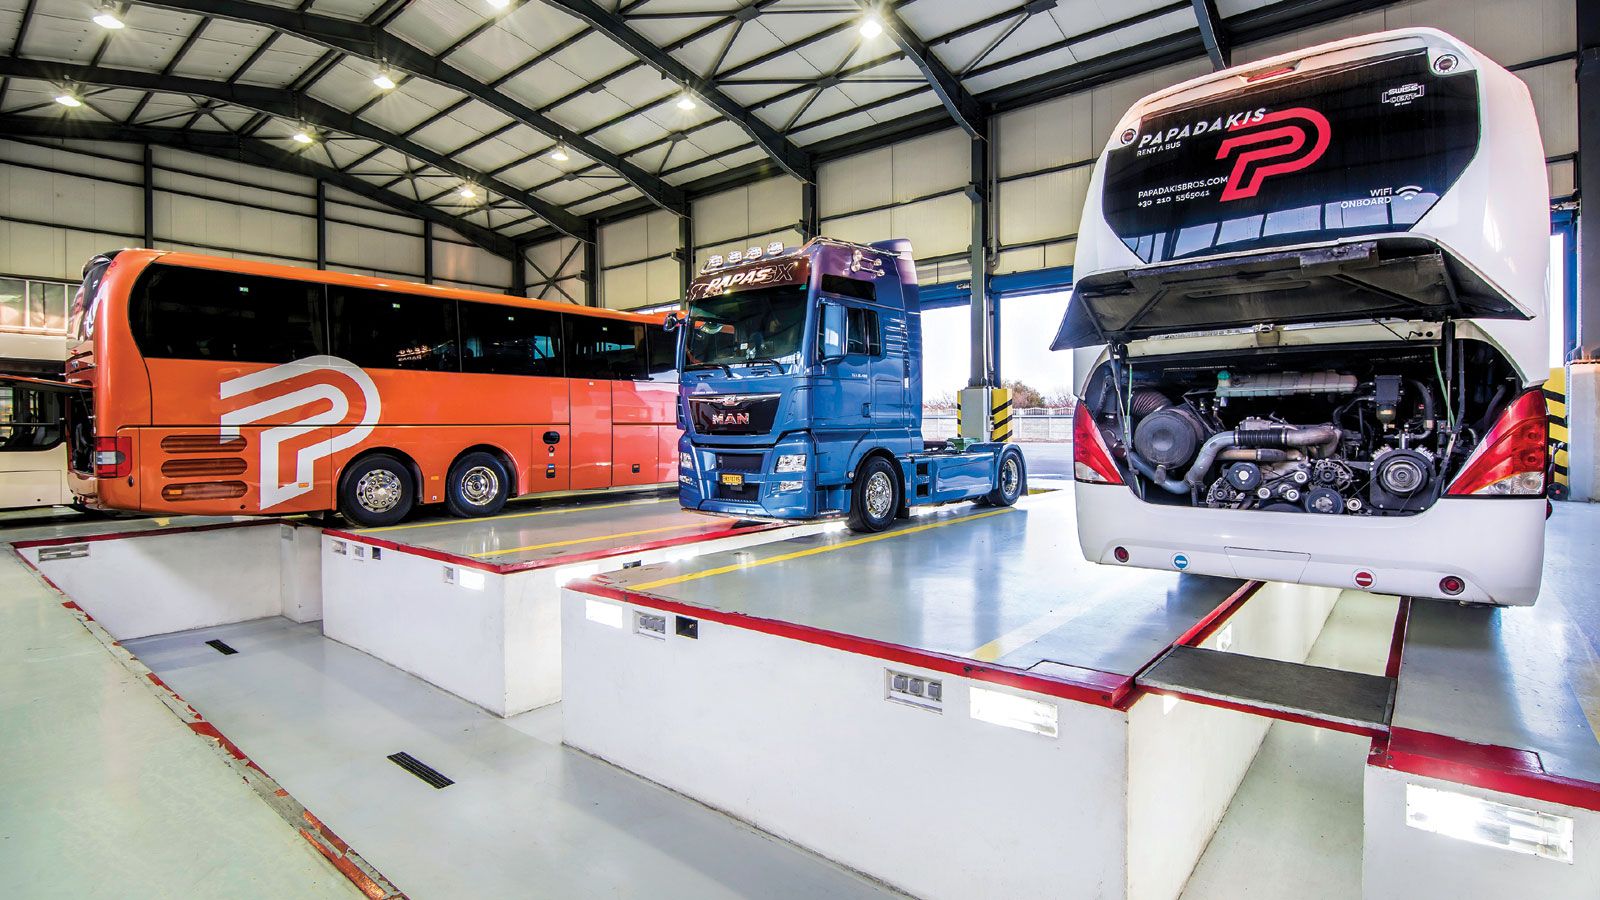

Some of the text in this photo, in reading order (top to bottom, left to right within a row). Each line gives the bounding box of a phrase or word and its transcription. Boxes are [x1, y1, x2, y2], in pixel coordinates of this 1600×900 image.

[1138, 107, 1266, 148] PAPADAKIS
[1136, 147, 1157, 157] RENT
[1165, 141, 1181, 150] BUS
[1138, 176, 1229, 198] PAPADAKISBROS.COM
[1156, 196, 1171, 204] 210
[1175, 190, 1210, 202] 5565041
[1340, 197, 1392, 208] ONBOARD
[706, 267, 774, 290] PAPAS
[712, 413, 750, 424] MAN
